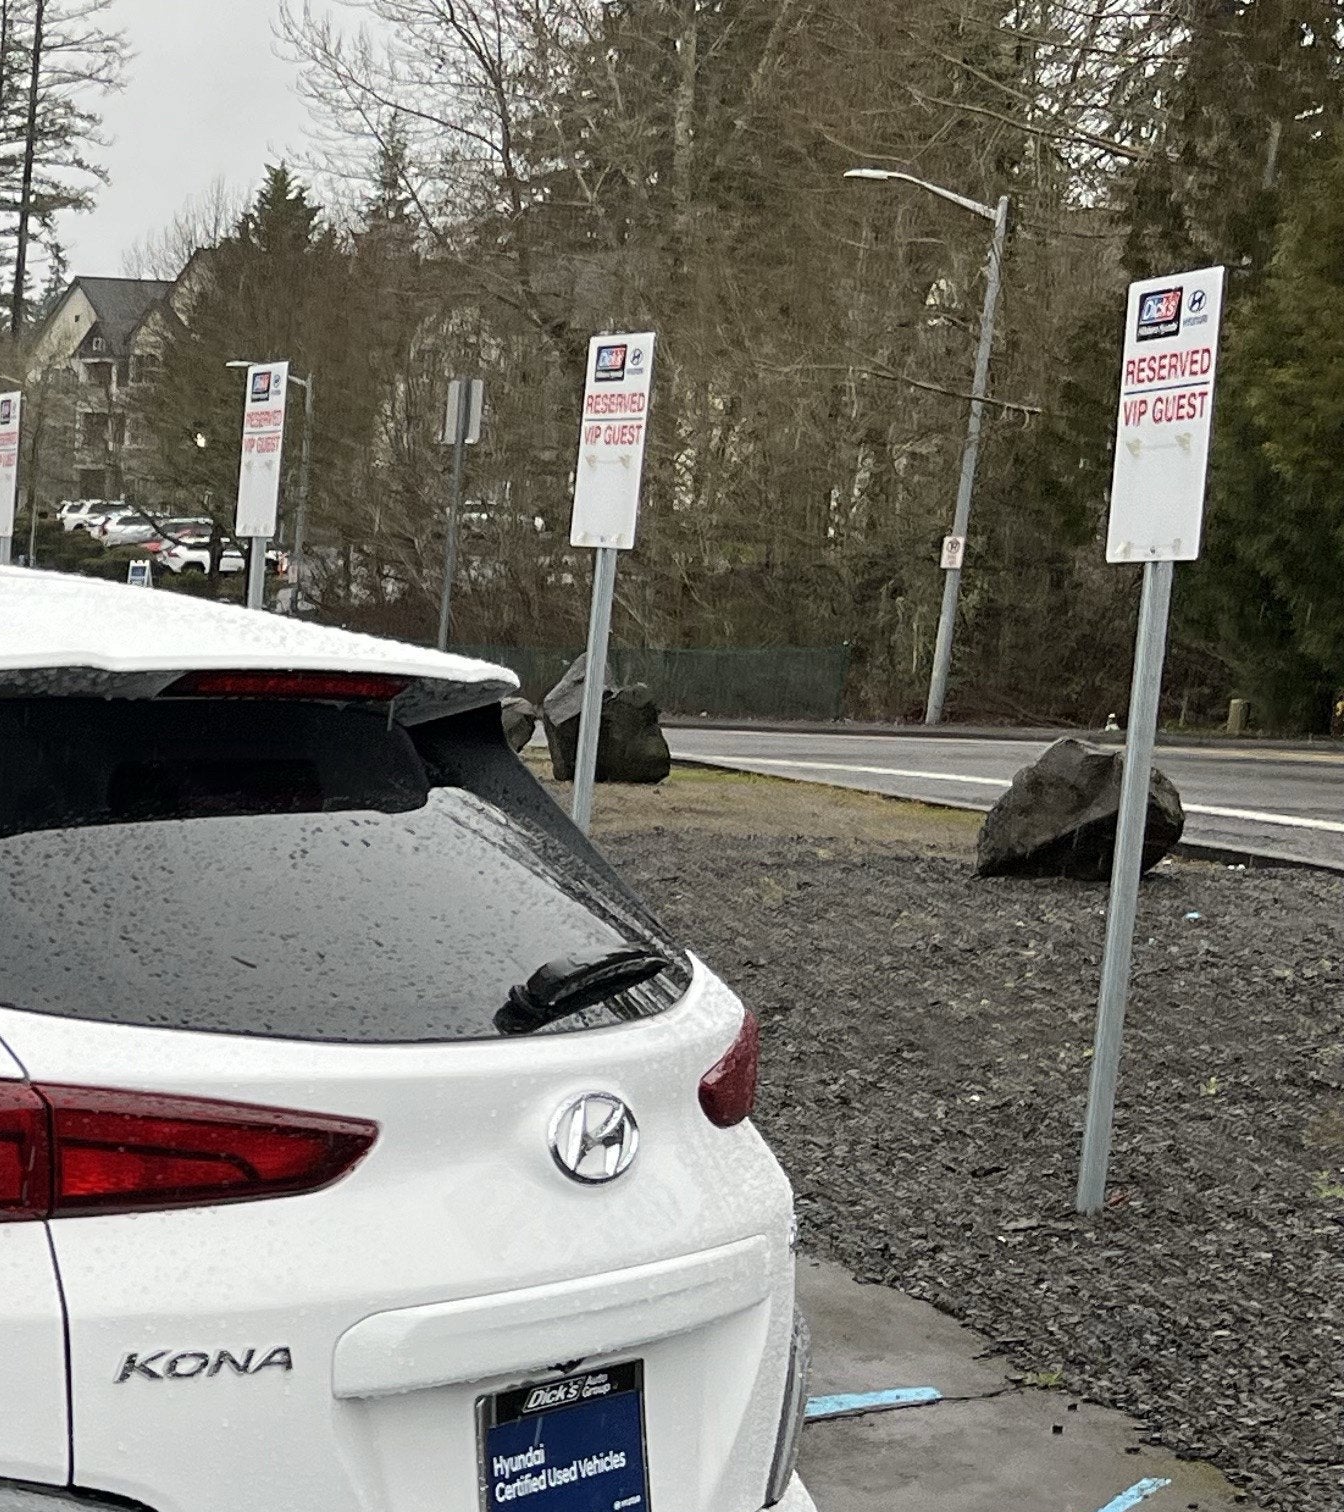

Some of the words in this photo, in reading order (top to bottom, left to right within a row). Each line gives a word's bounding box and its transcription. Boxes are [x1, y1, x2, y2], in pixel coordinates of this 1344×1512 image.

[1126, 348, 1211, 385] RESERVED
[586, 393, 645, 414] RESERVED
[1123, 399, 1147, 427] VIP
[1152, 391, 1208, 425] GUEST
[584, 426, 601, 446] VIP
[603, 424, 643, 446] GUEST
[113, 1346, 293, 1383] KONA
[527, 1381, 580, 1408] Dick's
[493, 1443, 545, 1478] Hyundai
[495, 1469, 547, 1503] Certified
[547, 1460, 577, 1487] Used
[577, 1450, 627, 1479] Vehicles
